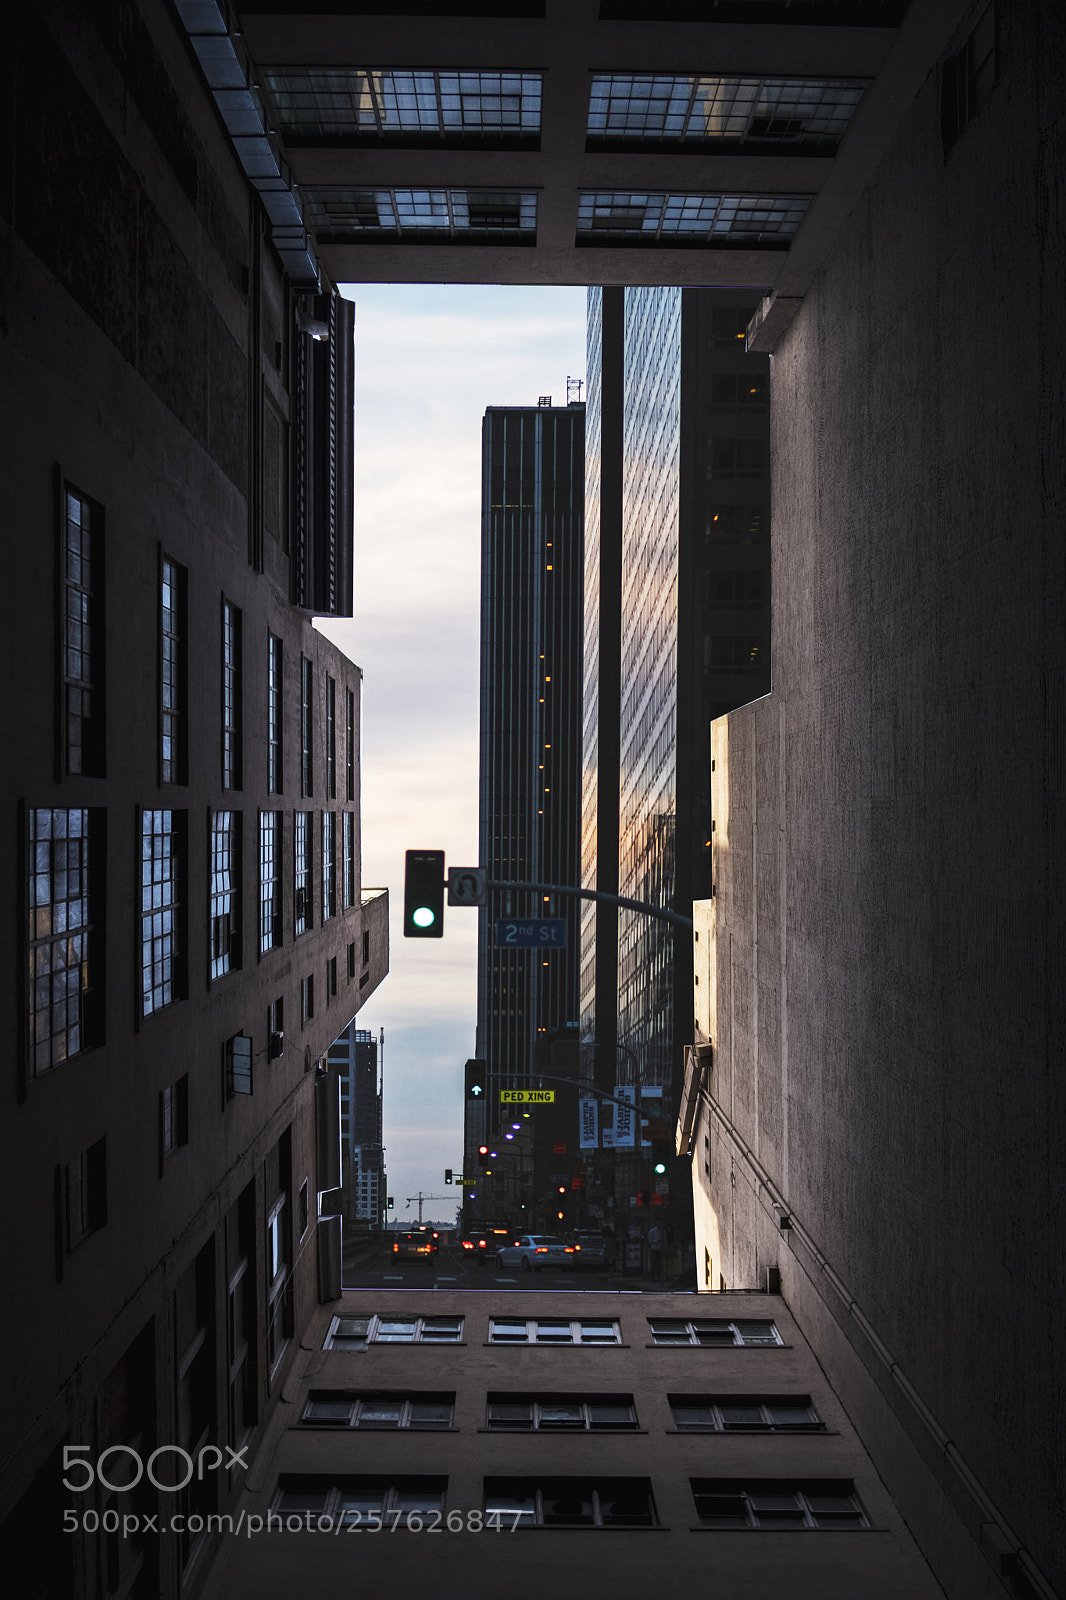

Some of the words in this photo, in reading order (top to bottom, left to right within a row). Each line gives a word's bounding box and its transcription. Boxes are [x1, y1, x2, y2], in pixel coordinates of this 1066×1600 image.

[505, 924, 534, 942] 2nd
[539, 925, 557, 941] St
[504, 1092, 524, 1102] PED
[528, 1092, 551, 1102] XING
[617, 1089, 625, 1131] JASPR
